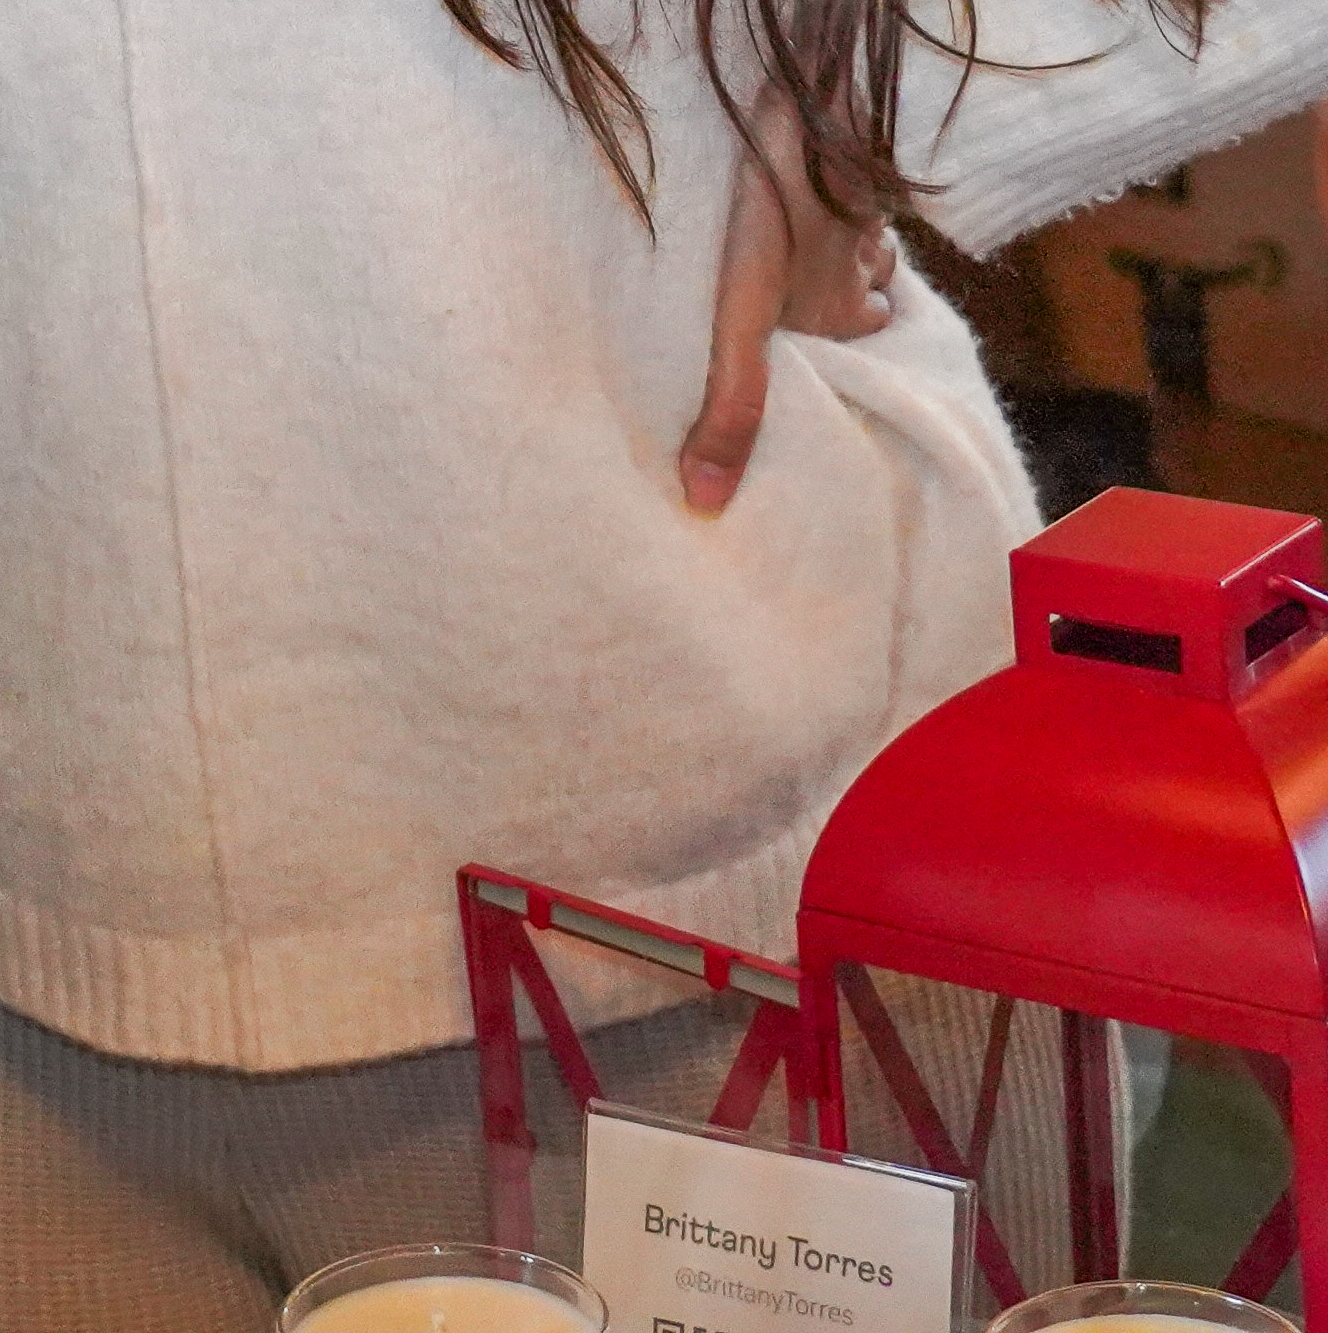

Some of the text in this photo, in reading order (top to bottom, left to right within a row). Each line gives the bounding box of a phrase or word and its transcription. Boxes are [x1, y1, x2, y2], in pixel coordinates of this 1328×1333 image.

[644, 1204, 894, 1287] Brittany Torres
[675, 1267, 854, 1326] @BrittanyTorres
